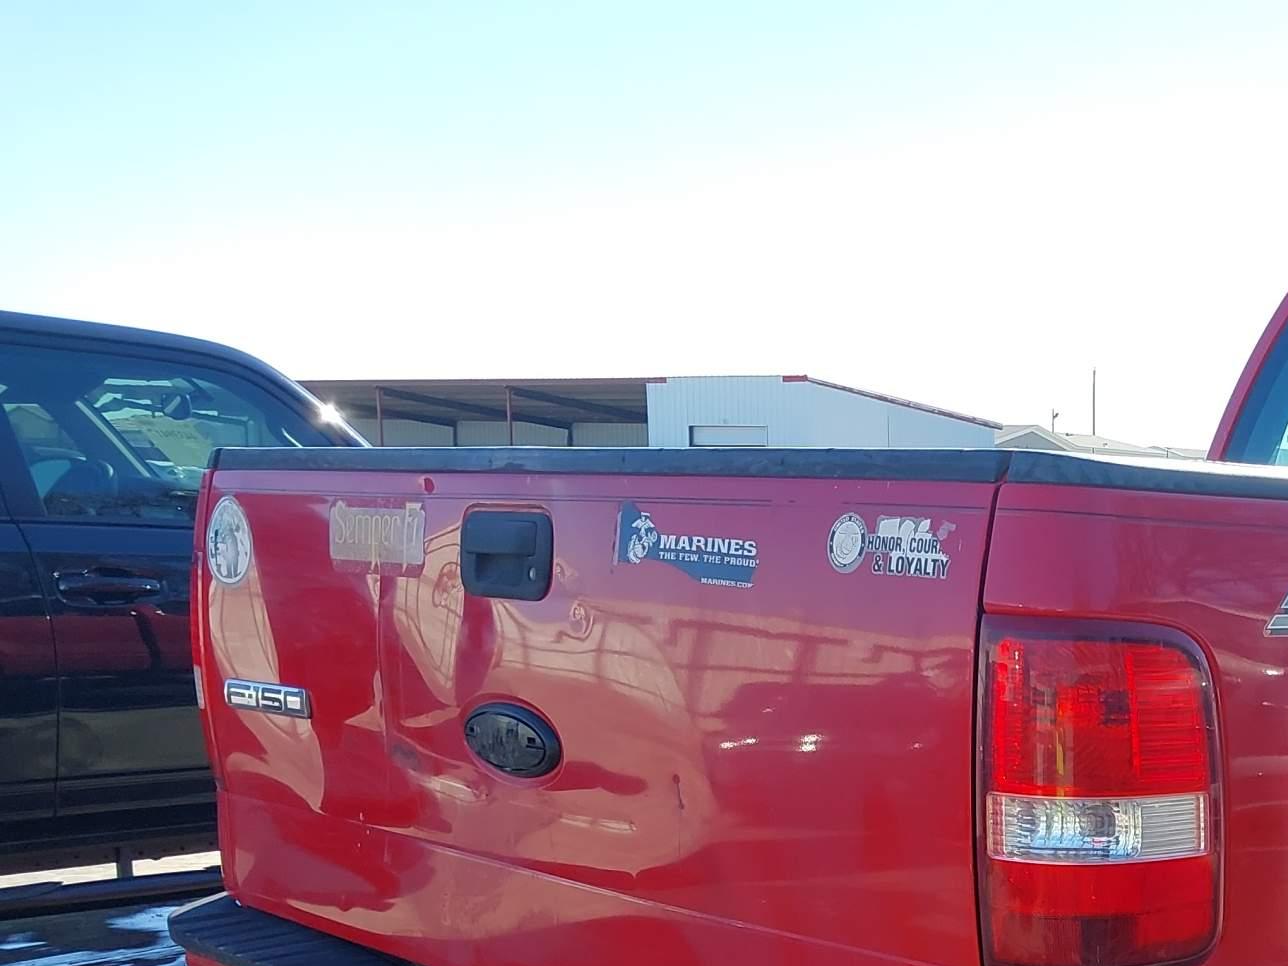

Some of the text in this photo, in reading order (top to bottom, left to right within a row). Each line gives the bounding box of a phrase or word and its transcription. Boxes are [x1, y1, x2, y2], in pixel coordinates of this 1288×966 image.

[335, 501, 401, 558] Semper
[659, 534, 758, 557] MARINES
[867, 535, 906, 554] HONOR,
[659, 551, 677, 561] THE
[679, 553, 700, 562] FEW.
[703, 554, 721, 565] THE
[872, 554, 950, 577] & LOYALTY
